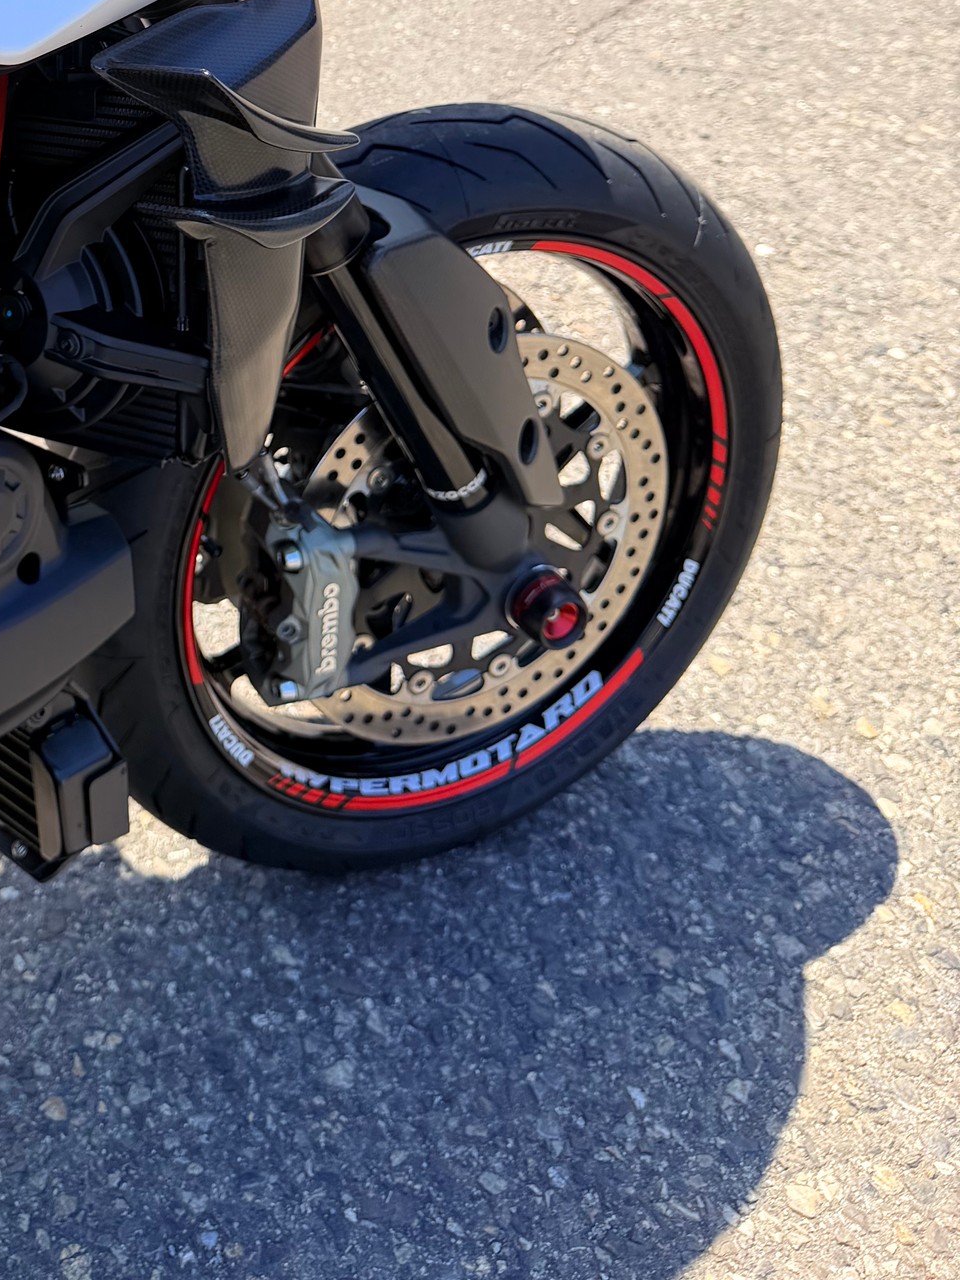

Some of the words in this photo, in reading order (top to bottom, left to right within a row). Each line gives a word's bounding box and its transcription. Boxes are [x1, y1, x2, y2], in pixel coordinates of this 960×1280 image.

[465, 240, 513, 257] CATI
[656, 558, 700, 628] DUCATI
[315, 582, 340, 675] brembo
[208, 713, 255, 768] DUCATI
[279, 670, 605, 796] HYPERMOTARD
